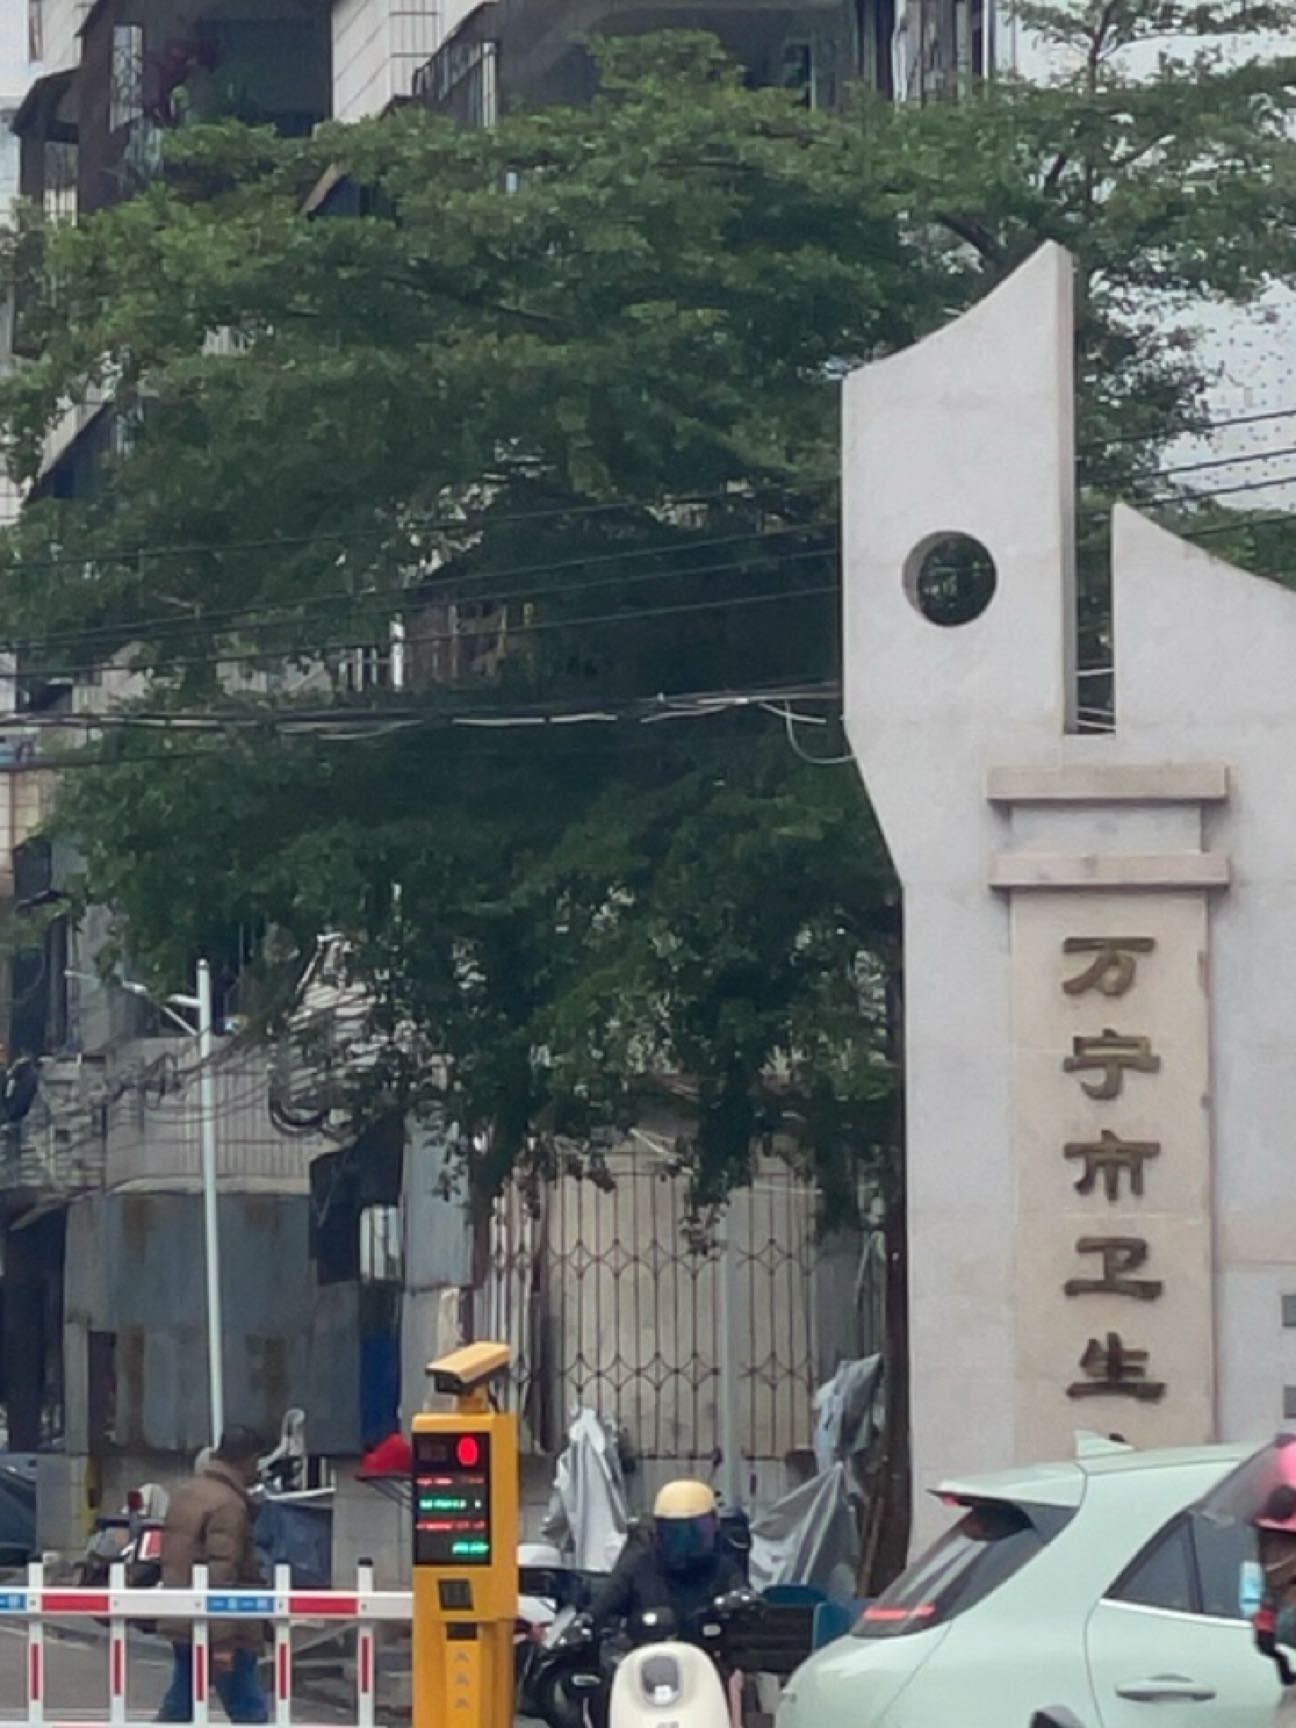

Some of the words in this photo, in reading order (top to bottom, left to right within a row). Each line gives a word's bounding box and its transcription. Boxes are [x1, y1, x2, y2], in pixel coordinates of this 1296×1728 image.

[1062, 937, 1166, 1442] 万宁市卫生
